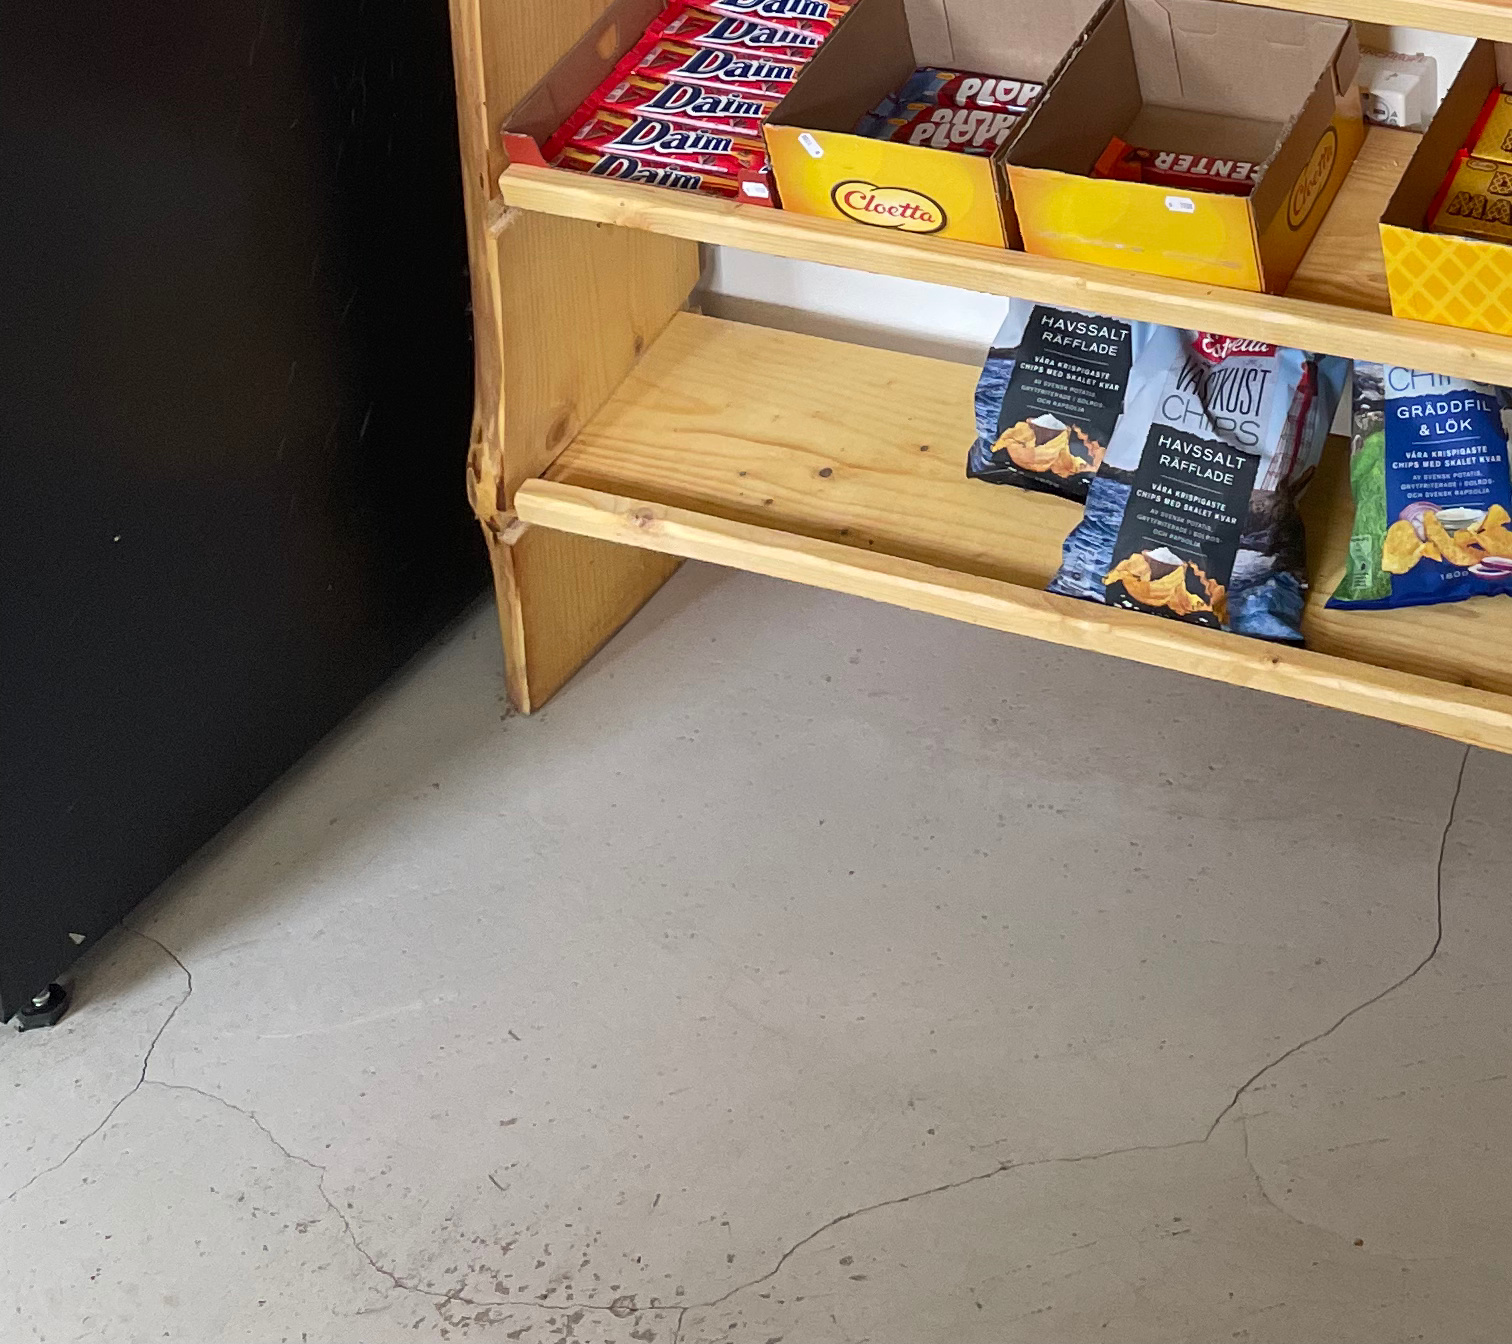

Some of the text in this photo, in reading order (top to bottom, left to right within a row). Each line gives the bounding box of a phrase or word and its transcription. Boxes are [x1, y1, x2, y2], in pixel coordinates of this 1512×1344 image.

[674, 47, 797, 82] Daim
[642, 81, 766, 118] Daim
[955, 74, 1044, 106] PLOP
[611, 116, 734, 155] Daim
[587, 153, 703, 191] Daim
[1291, 142, 1338, 218] Cloetta
[843, 187, 936, 225] Cloetta
[1040, 314, 1130, 342] HAVSSALT
[1041, 330, 1119, 357] RÄFFLADE
[1019, 362, 1044, 375] CHIPS
[1066, 370, 1097, 388] SKALET
[1034, 355, 1111, 381] VÅRA KRISPIGASTE
[1397, 400, 1493, 419] GRÄDDFIL
[1419, 417, 1473, 436] & LÖK
[1158, 434, 1247, 470] HAVSSALT
[1392, 455, 1502, 470] CHIPS MED SKALET KVAR
[1405, 445, 1488, 459] VÅRA KRISPIGASTE
[1159, 454, 1235, 486] RÄFFLADE
[1136, 488, 1161, 501] CHIPS
[1182, 499, 1212, 519] SKALET
[1151, 482, 1227, 512] VÅRA KRISPIGASTE
